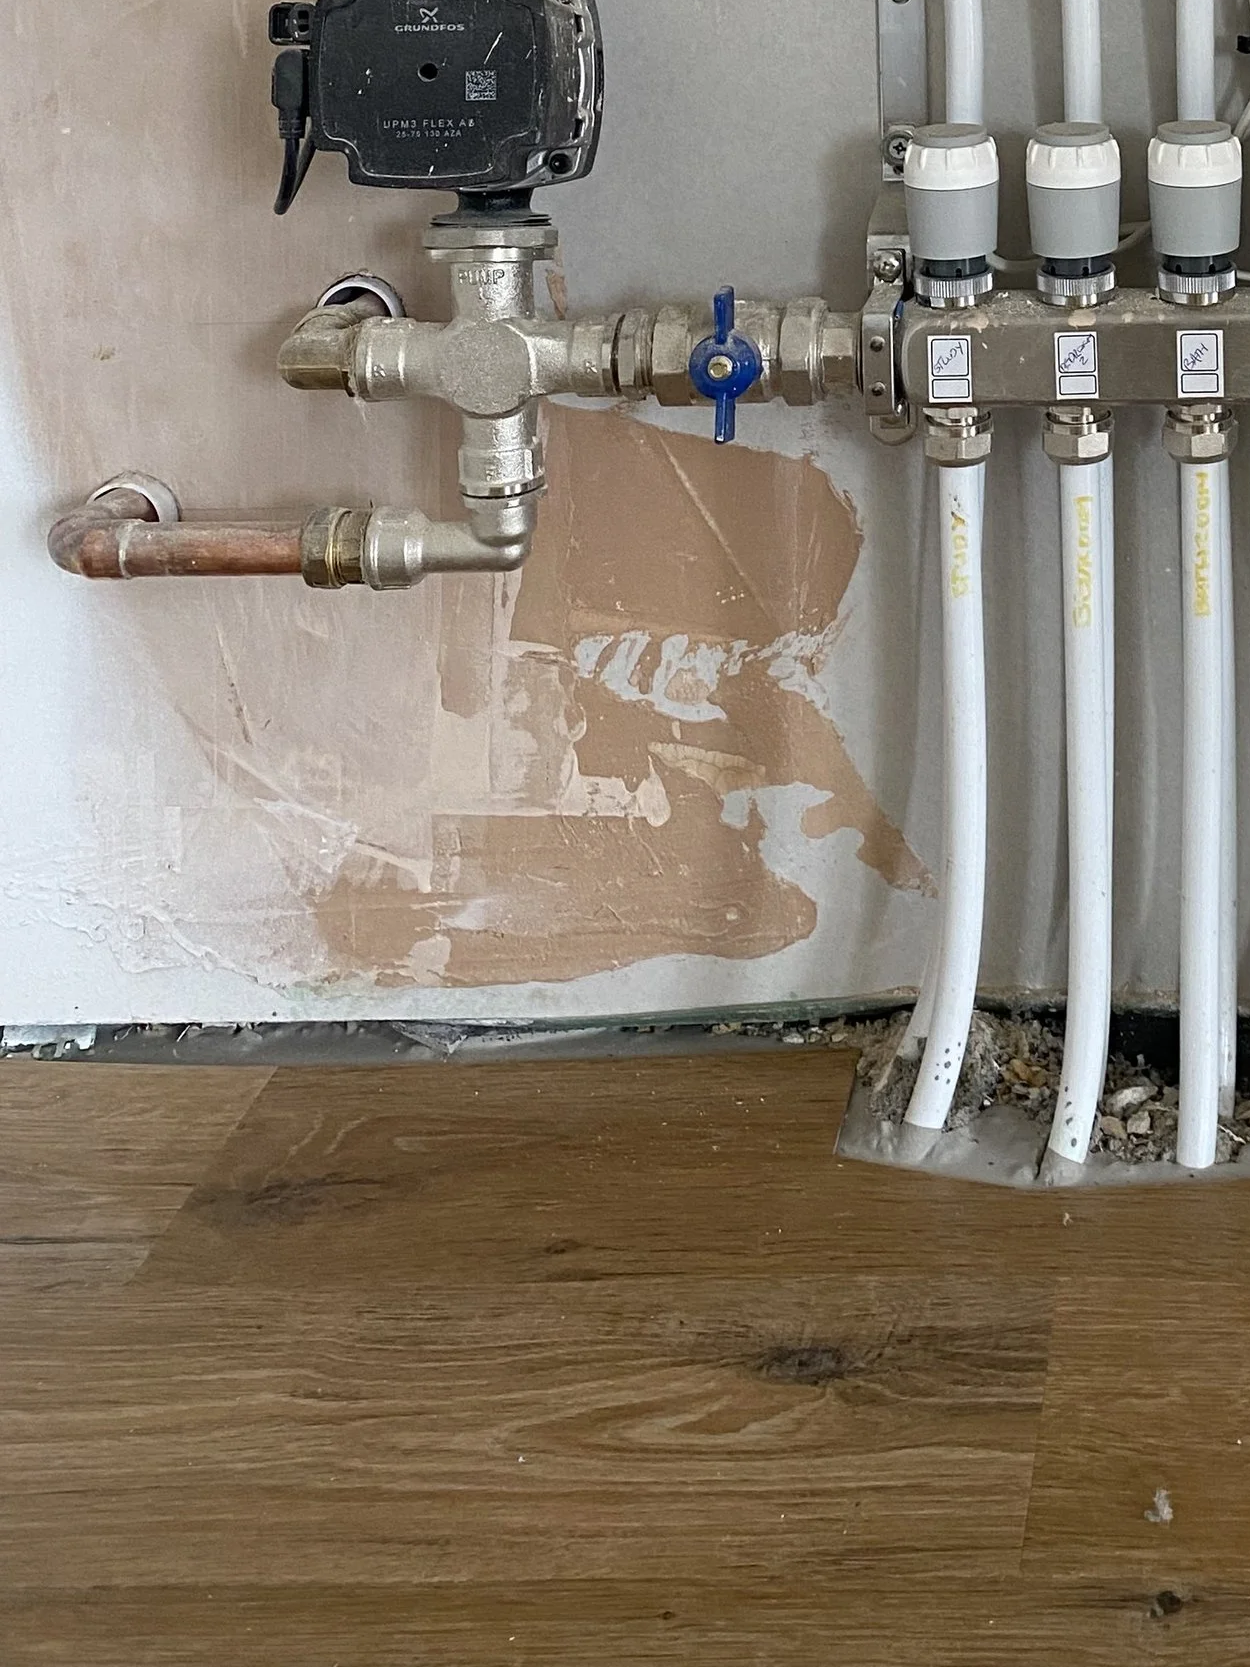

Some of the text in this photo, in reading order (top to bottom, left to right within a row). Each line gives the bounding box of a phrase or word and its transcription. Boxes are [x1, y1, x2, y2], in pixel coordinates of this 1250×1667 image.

[394, 23, 466, 32] GRUNDFOS
[383, 119, 417, 129] UPM3
[422, 118, 454, 128] FLEX
[932, 341, 965, 375] STUDY
[1183, 343, 1210, 372] BATH
